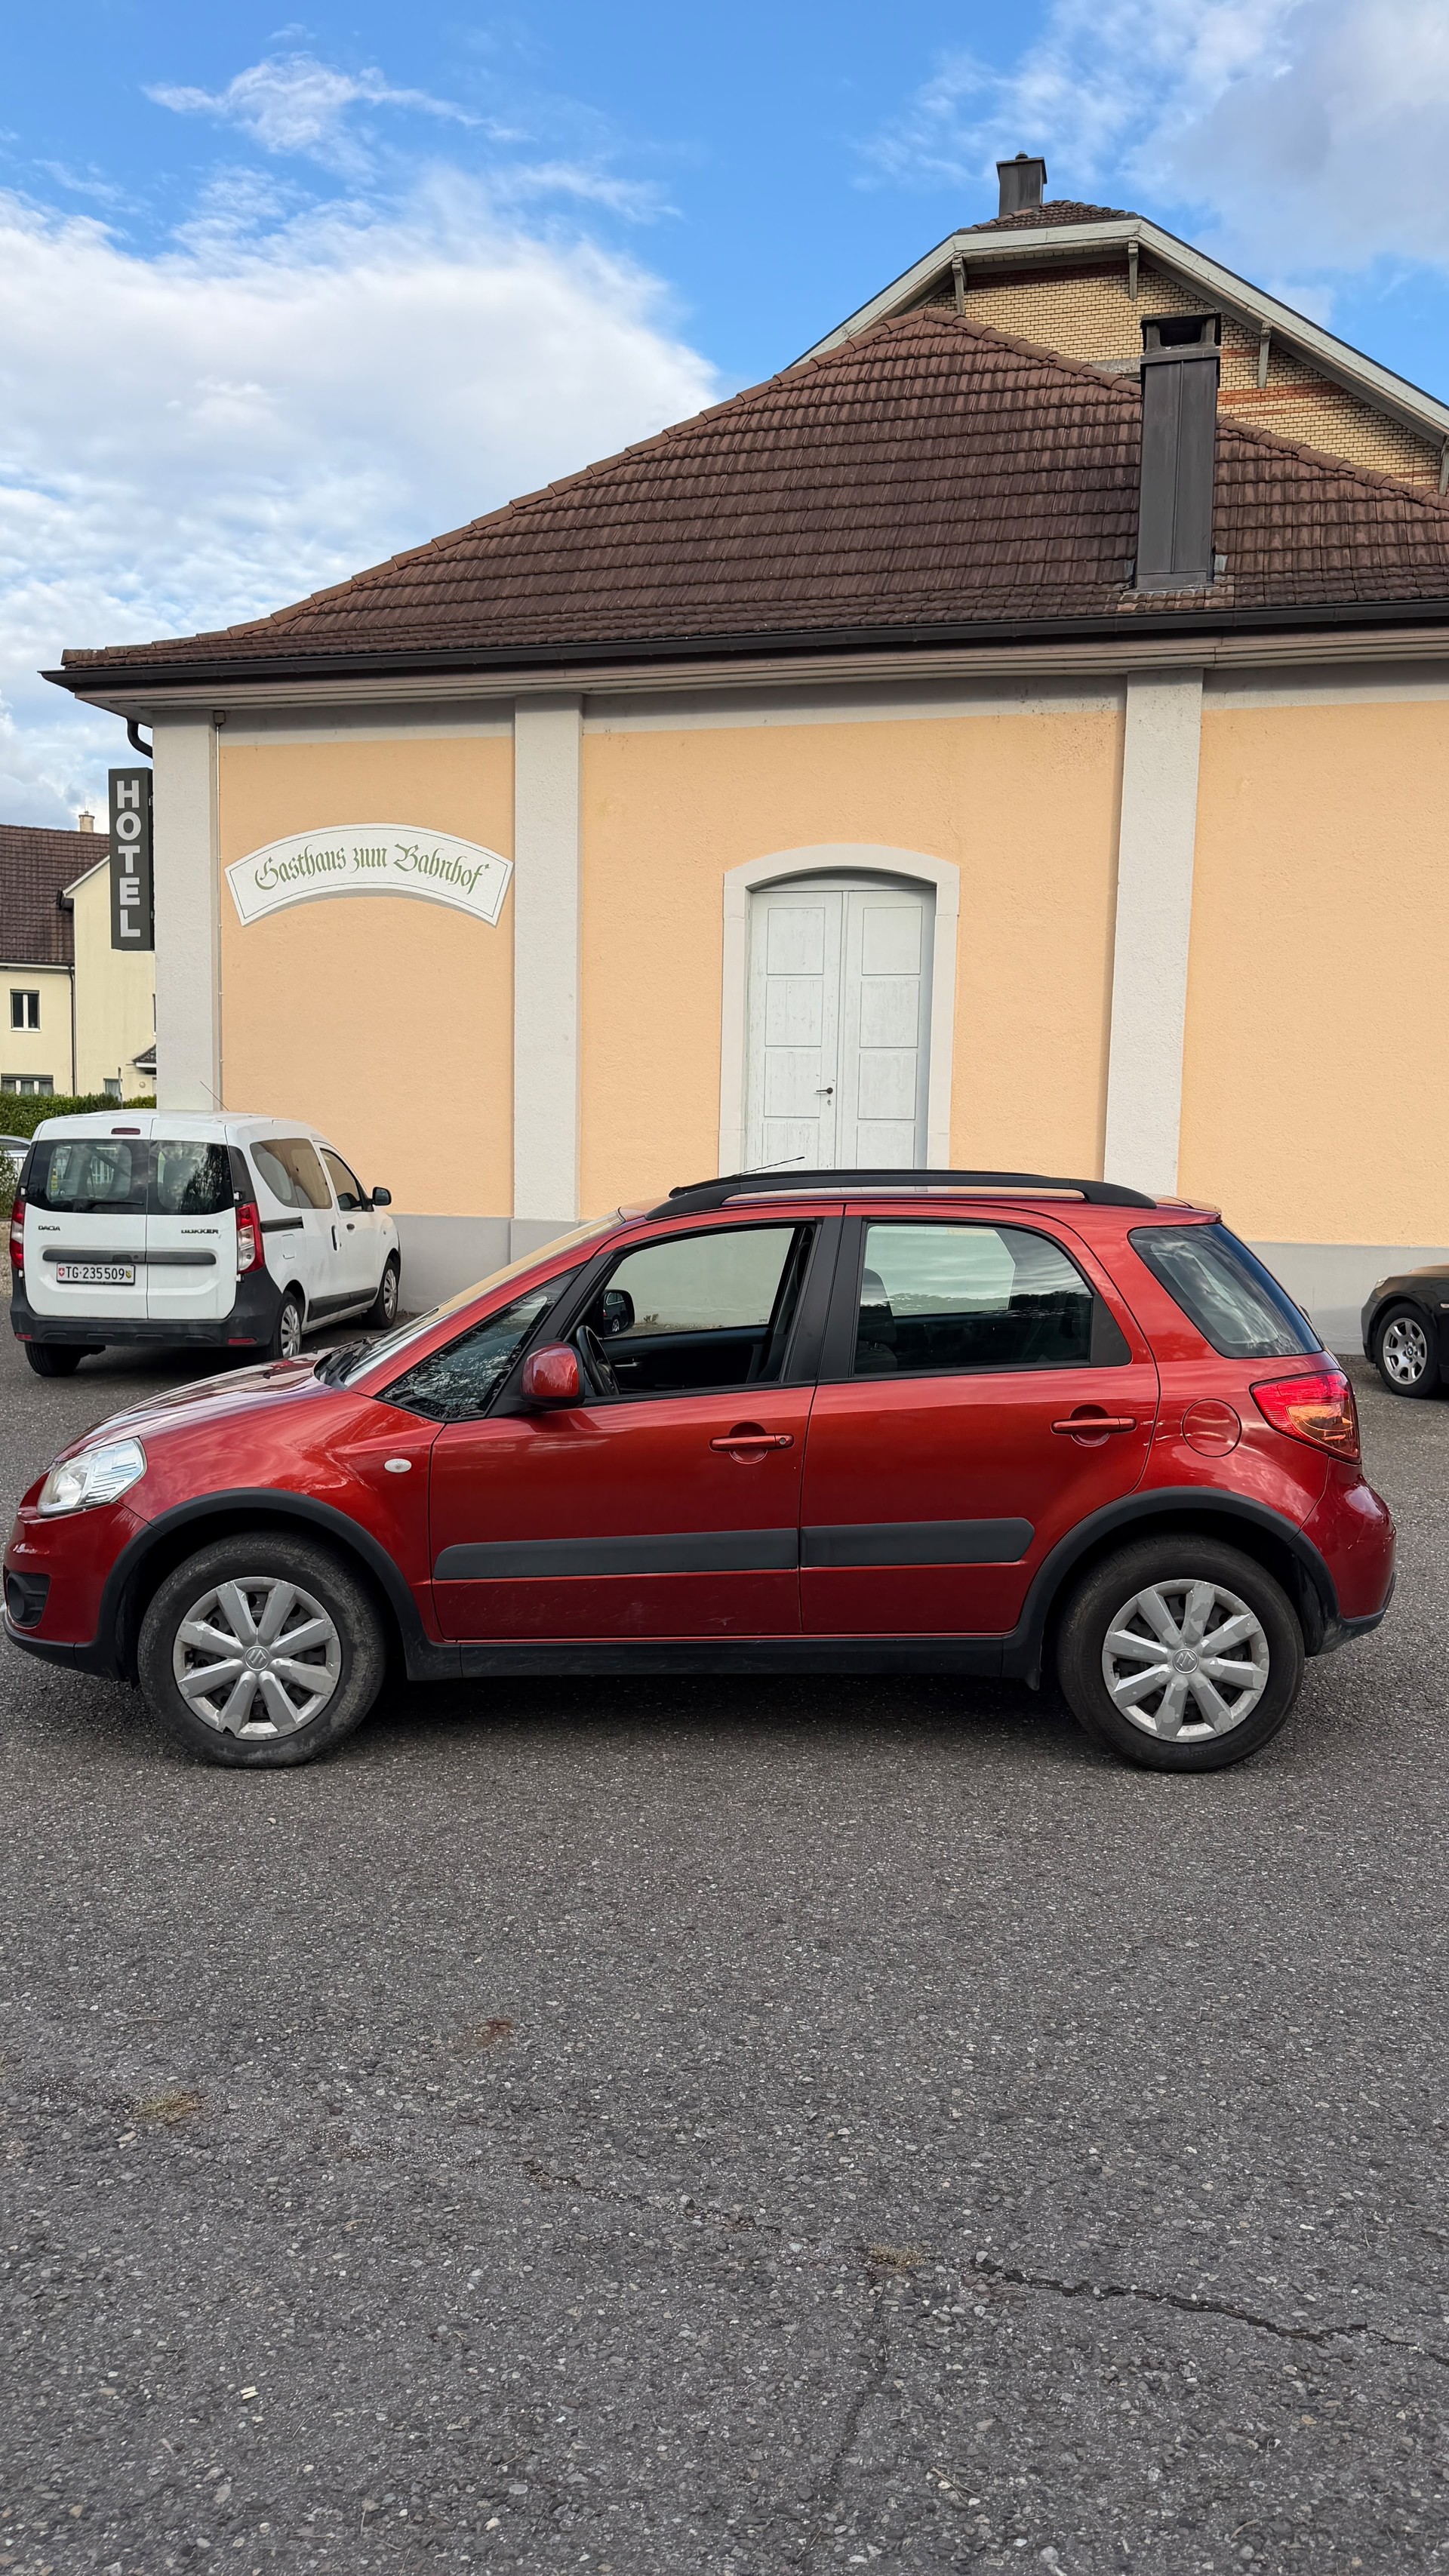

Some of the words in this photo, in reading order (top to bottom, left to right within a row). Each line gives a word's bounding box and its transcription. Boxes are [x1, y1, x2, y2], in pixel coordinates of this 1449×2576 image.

[116, 780, 141, 937] HOTEL
[254, 844, 346, 891] Gasthaus
[349, 847, 388, 873] zum
[393, 843, 491, 895] Bahnhof
